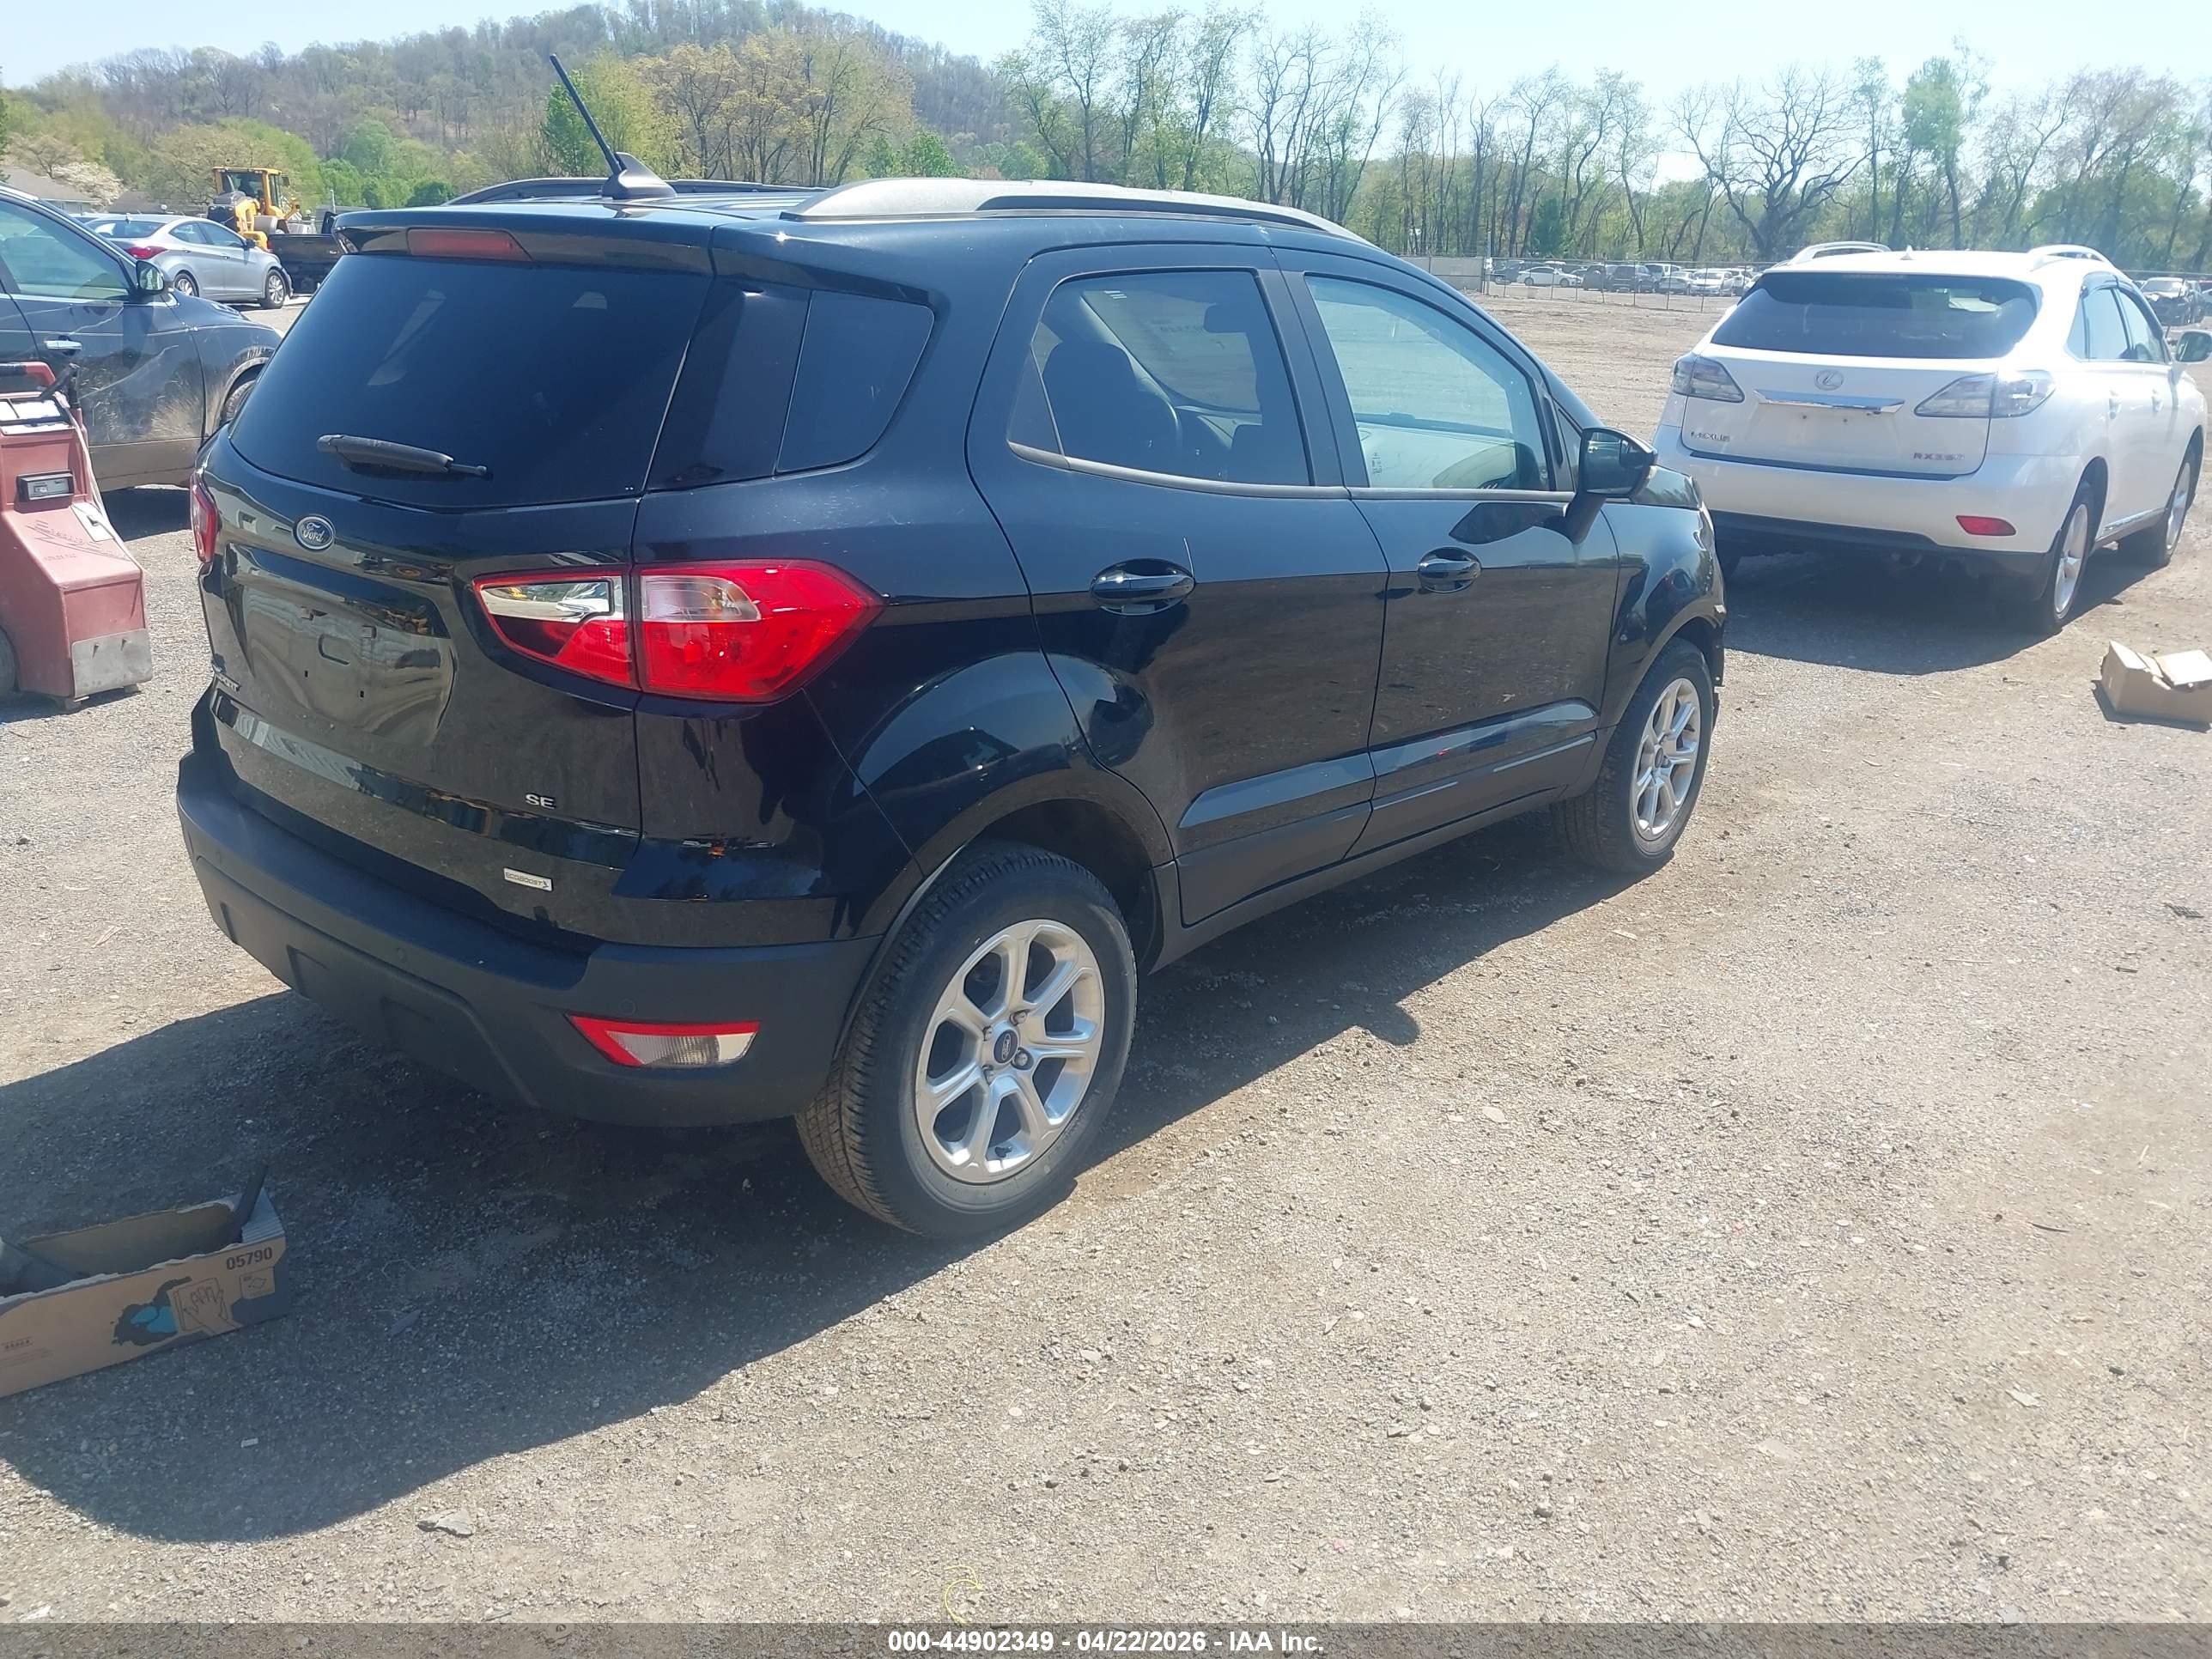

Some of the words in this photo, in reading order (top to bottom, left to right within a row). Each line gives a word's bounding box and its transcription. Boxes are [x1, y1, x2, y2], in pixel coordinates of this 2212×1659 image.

[303, 522, 325, 543] Ford
[525, 793, 556, 810] SE
[226, 1247, 273, 1271] 05790
